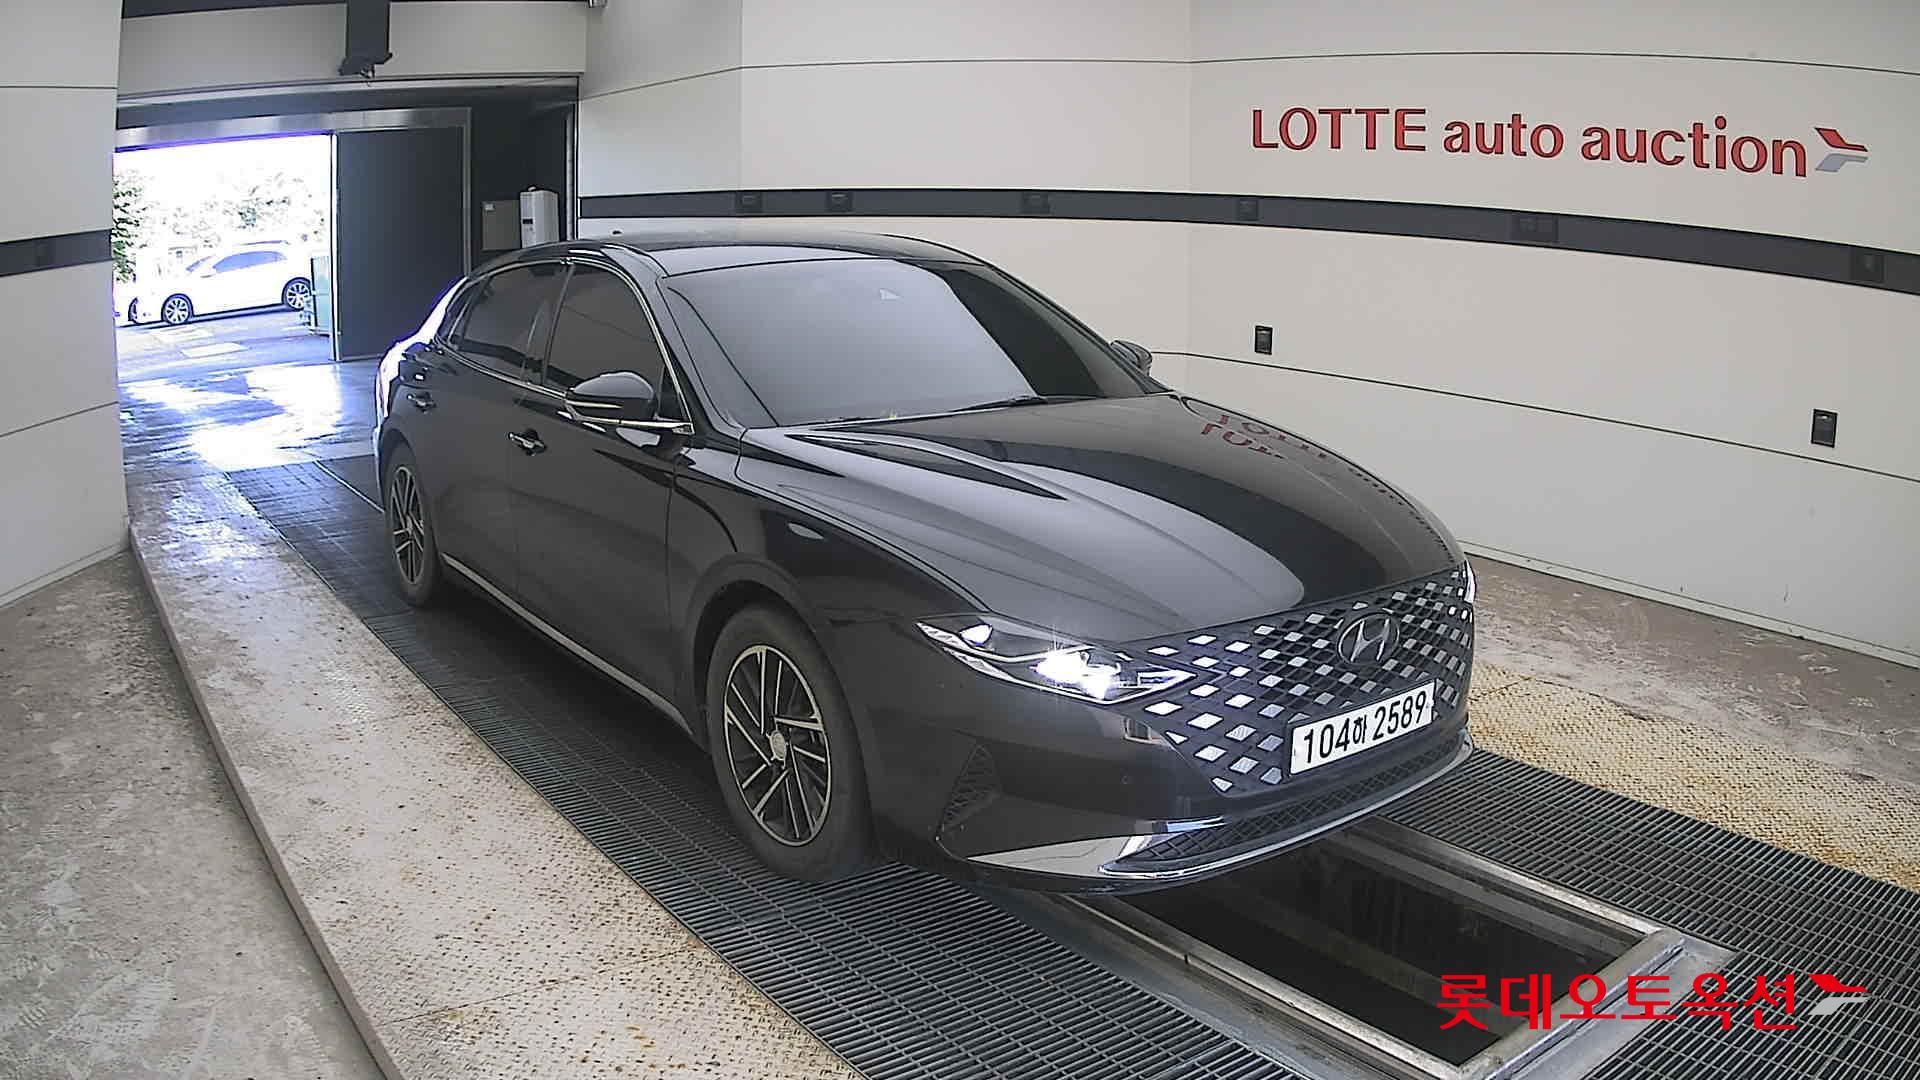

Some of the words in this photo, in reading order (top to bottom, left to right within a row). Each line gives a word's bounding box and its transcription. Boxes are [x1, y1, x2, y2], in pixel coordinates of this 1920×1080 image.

[1252, 107, 1426, 152] LOTTE
[1443, 114, 1566, 158] auto
[1582, 116, 1808, 178] auction
[1372, 691, 1427, 740] 2589
